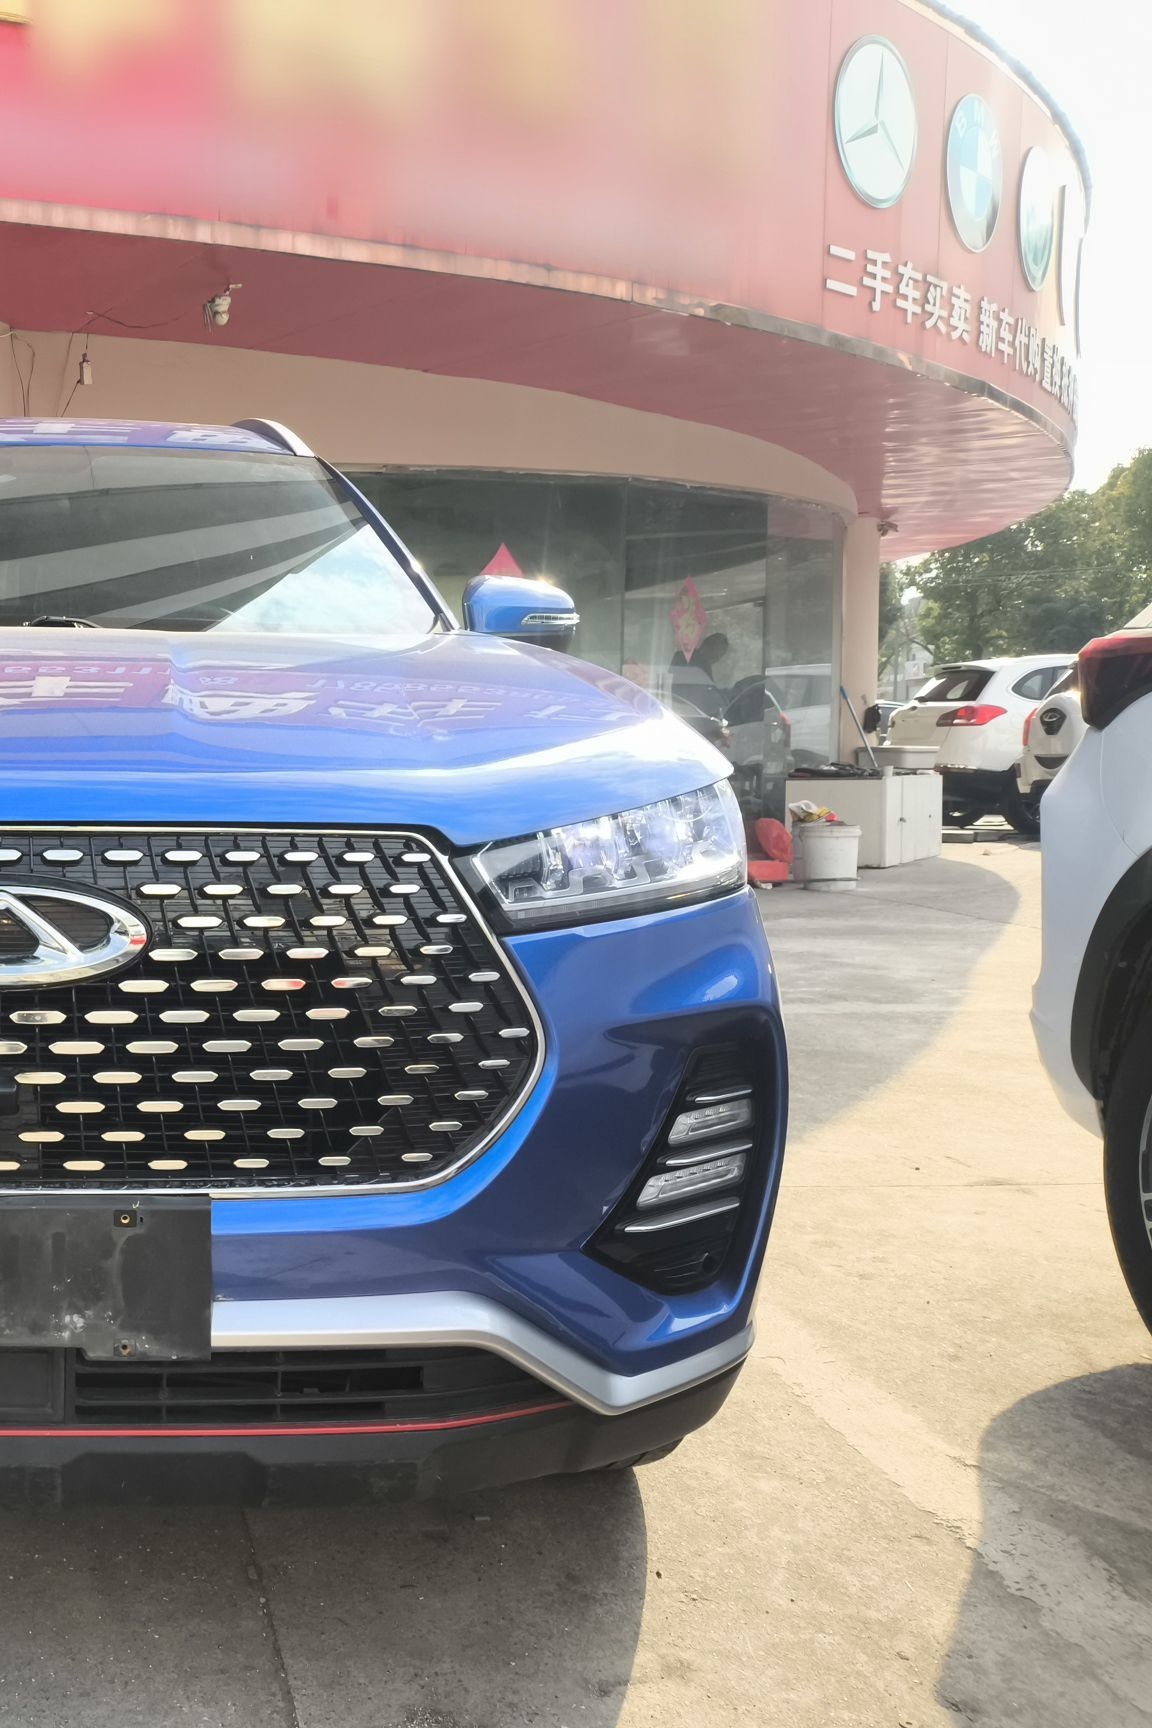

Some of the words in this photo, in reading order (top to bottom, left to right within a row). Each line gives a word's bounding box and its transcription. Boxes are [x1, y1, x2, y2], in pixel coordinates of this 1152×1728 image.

[826, 244, 972, 344] 二手车买卖
[978, 295, 1041, 383] 新车代购
